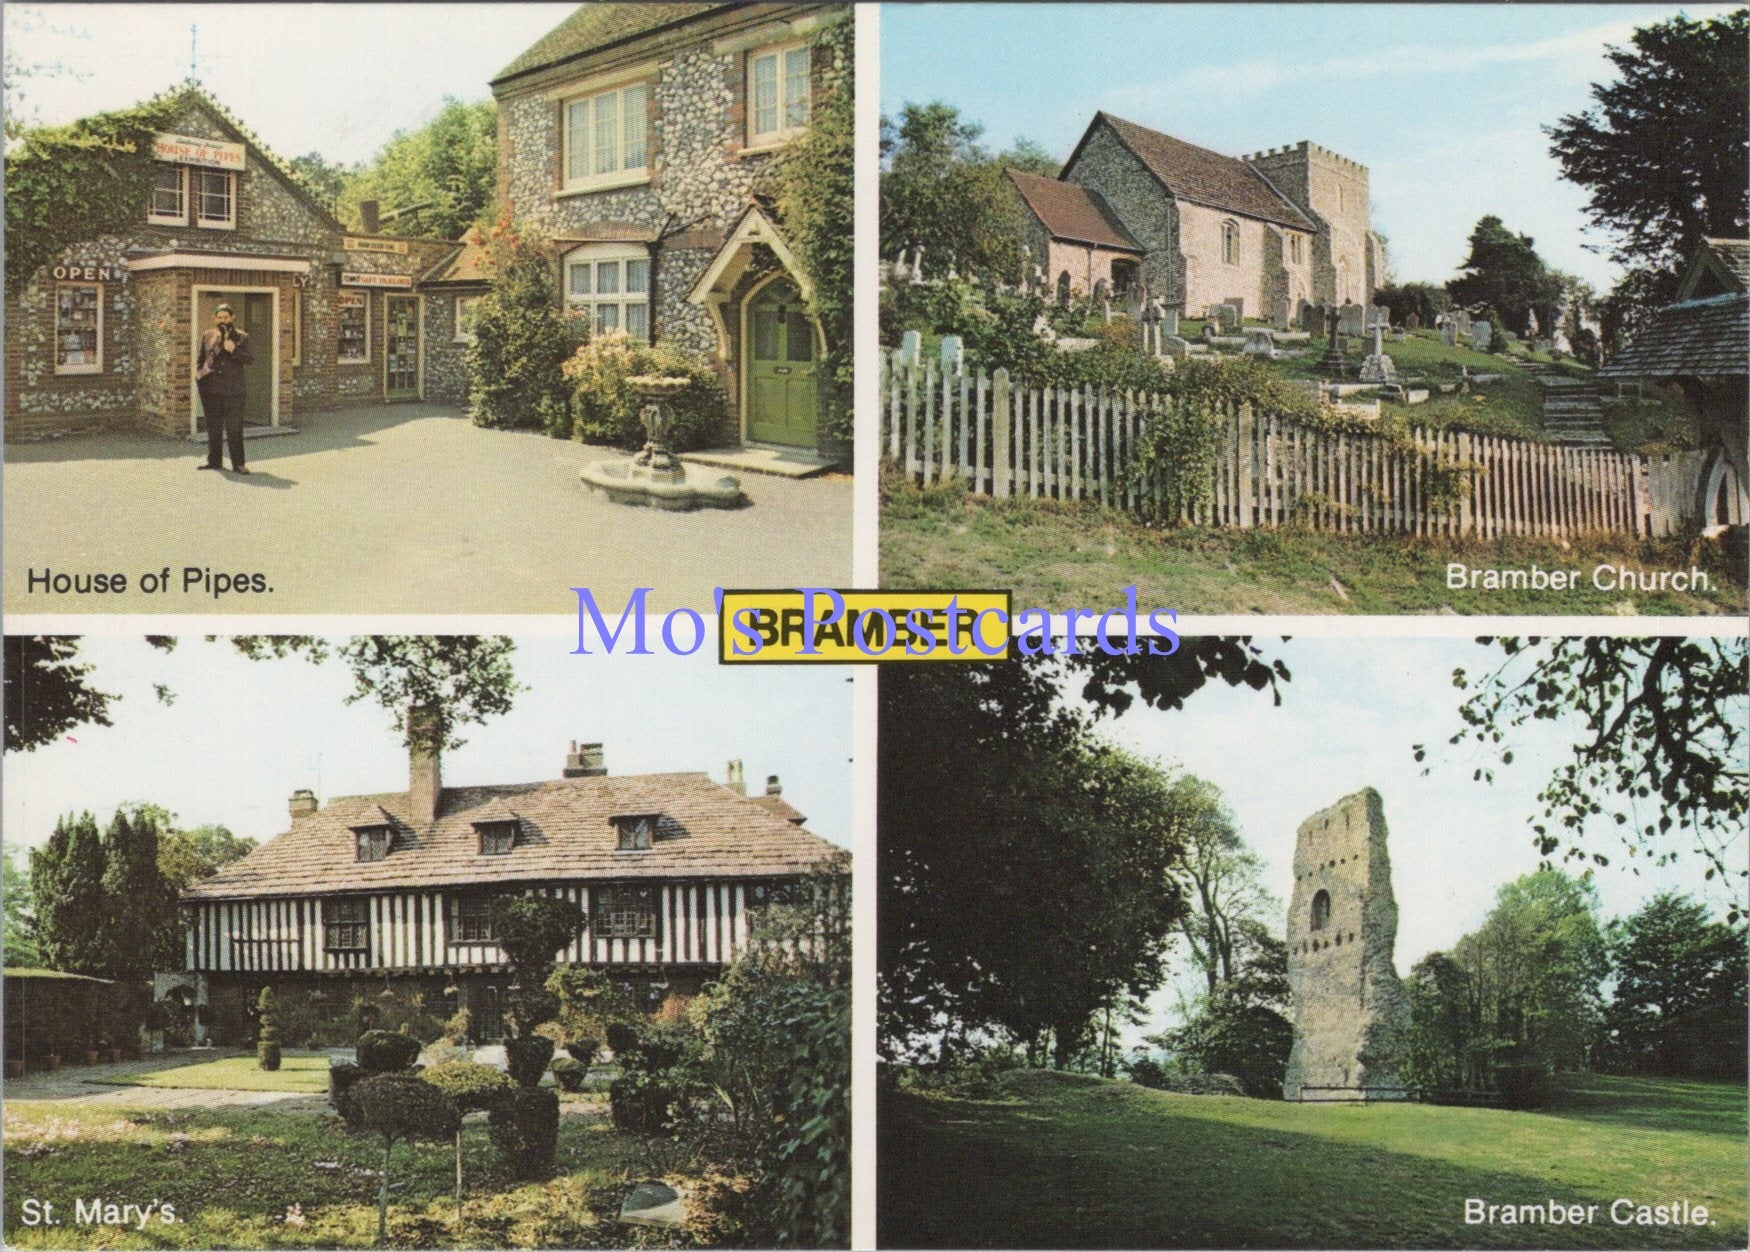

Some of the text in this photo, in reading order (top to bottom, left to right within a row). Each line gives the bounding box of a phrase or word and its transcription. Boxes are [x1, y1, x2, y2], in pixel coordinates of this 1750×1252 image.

[153, 143, 190, 156] HOUSE
[213, 150, 242, 163] PIPES
[53, 266, 110, 280] OPEN
